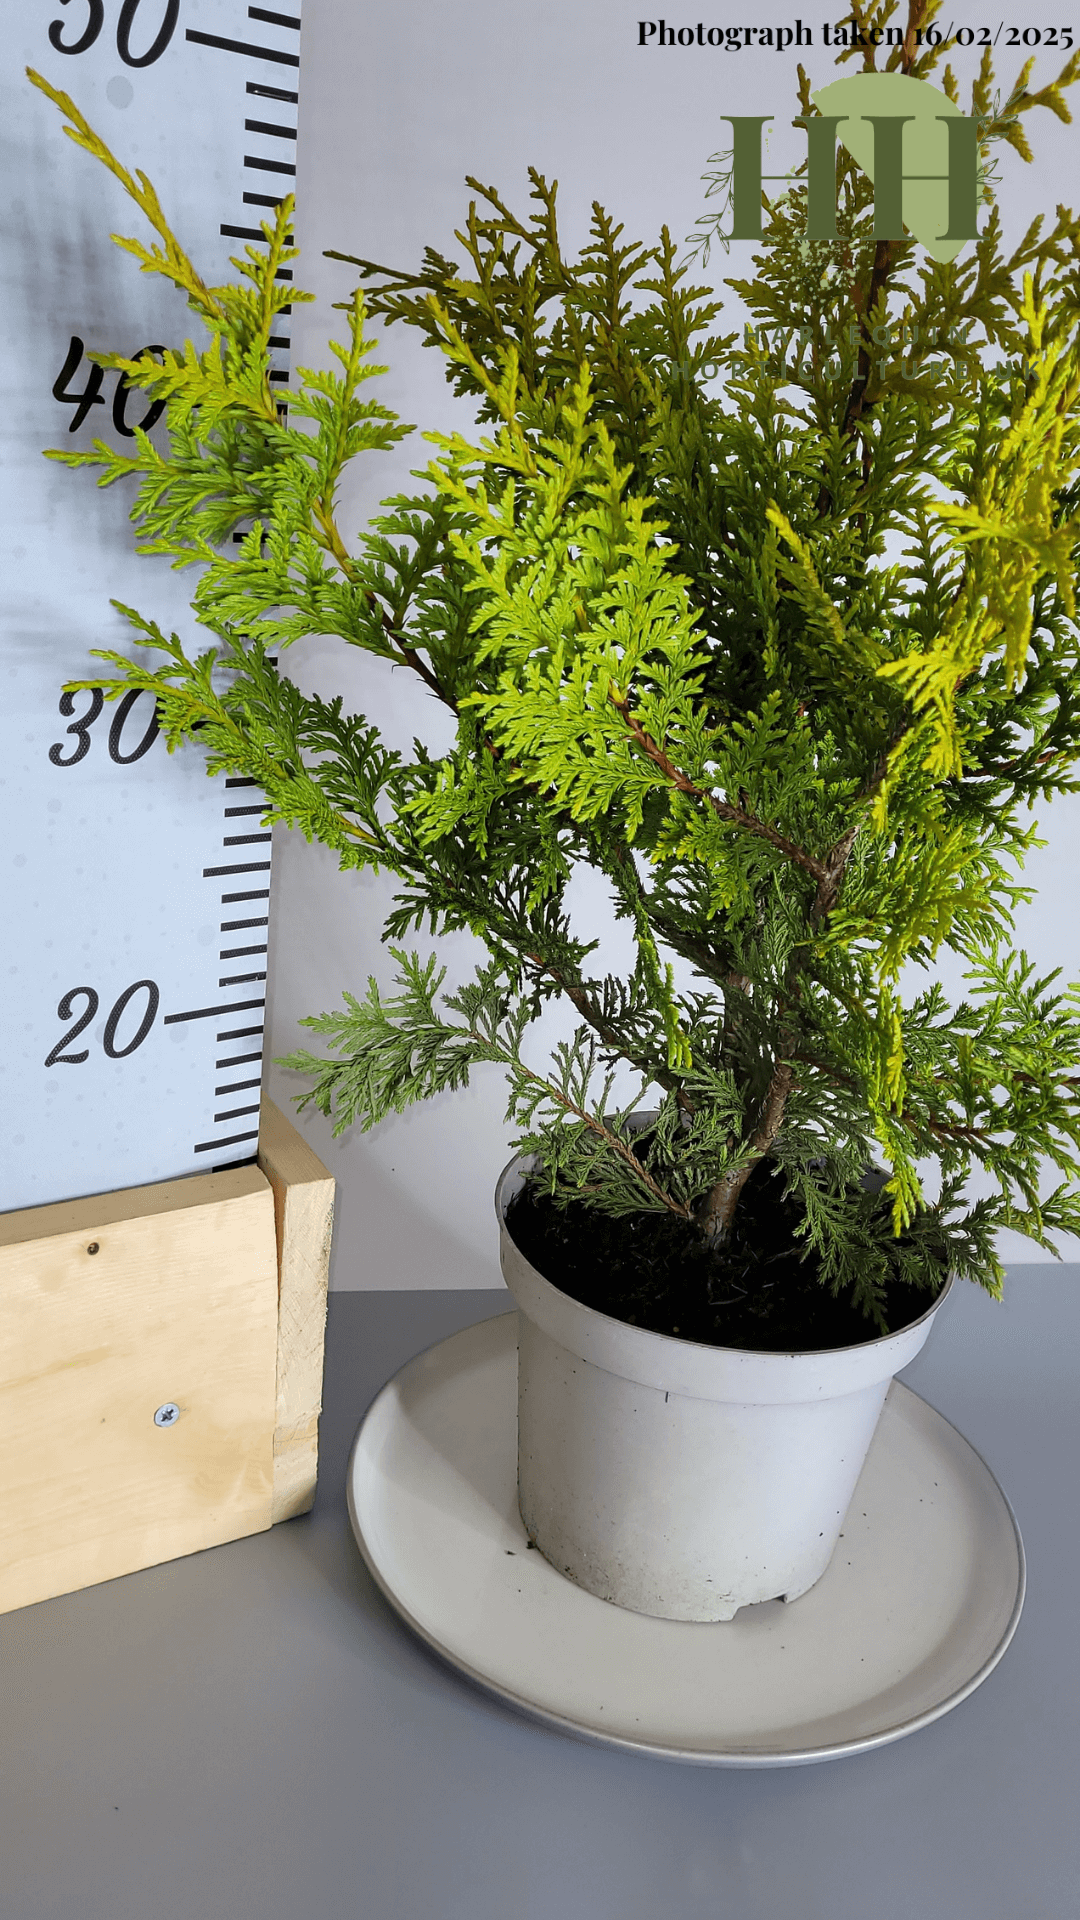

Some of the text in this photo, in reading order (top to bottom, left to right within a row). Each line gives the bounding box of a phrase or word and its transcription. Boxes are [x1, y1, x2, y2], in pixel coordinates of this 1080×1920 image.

[51, 335, 170, 437] 40
[48, 686, 162, 767] 30
[44, 979, 160, 1068] 20
